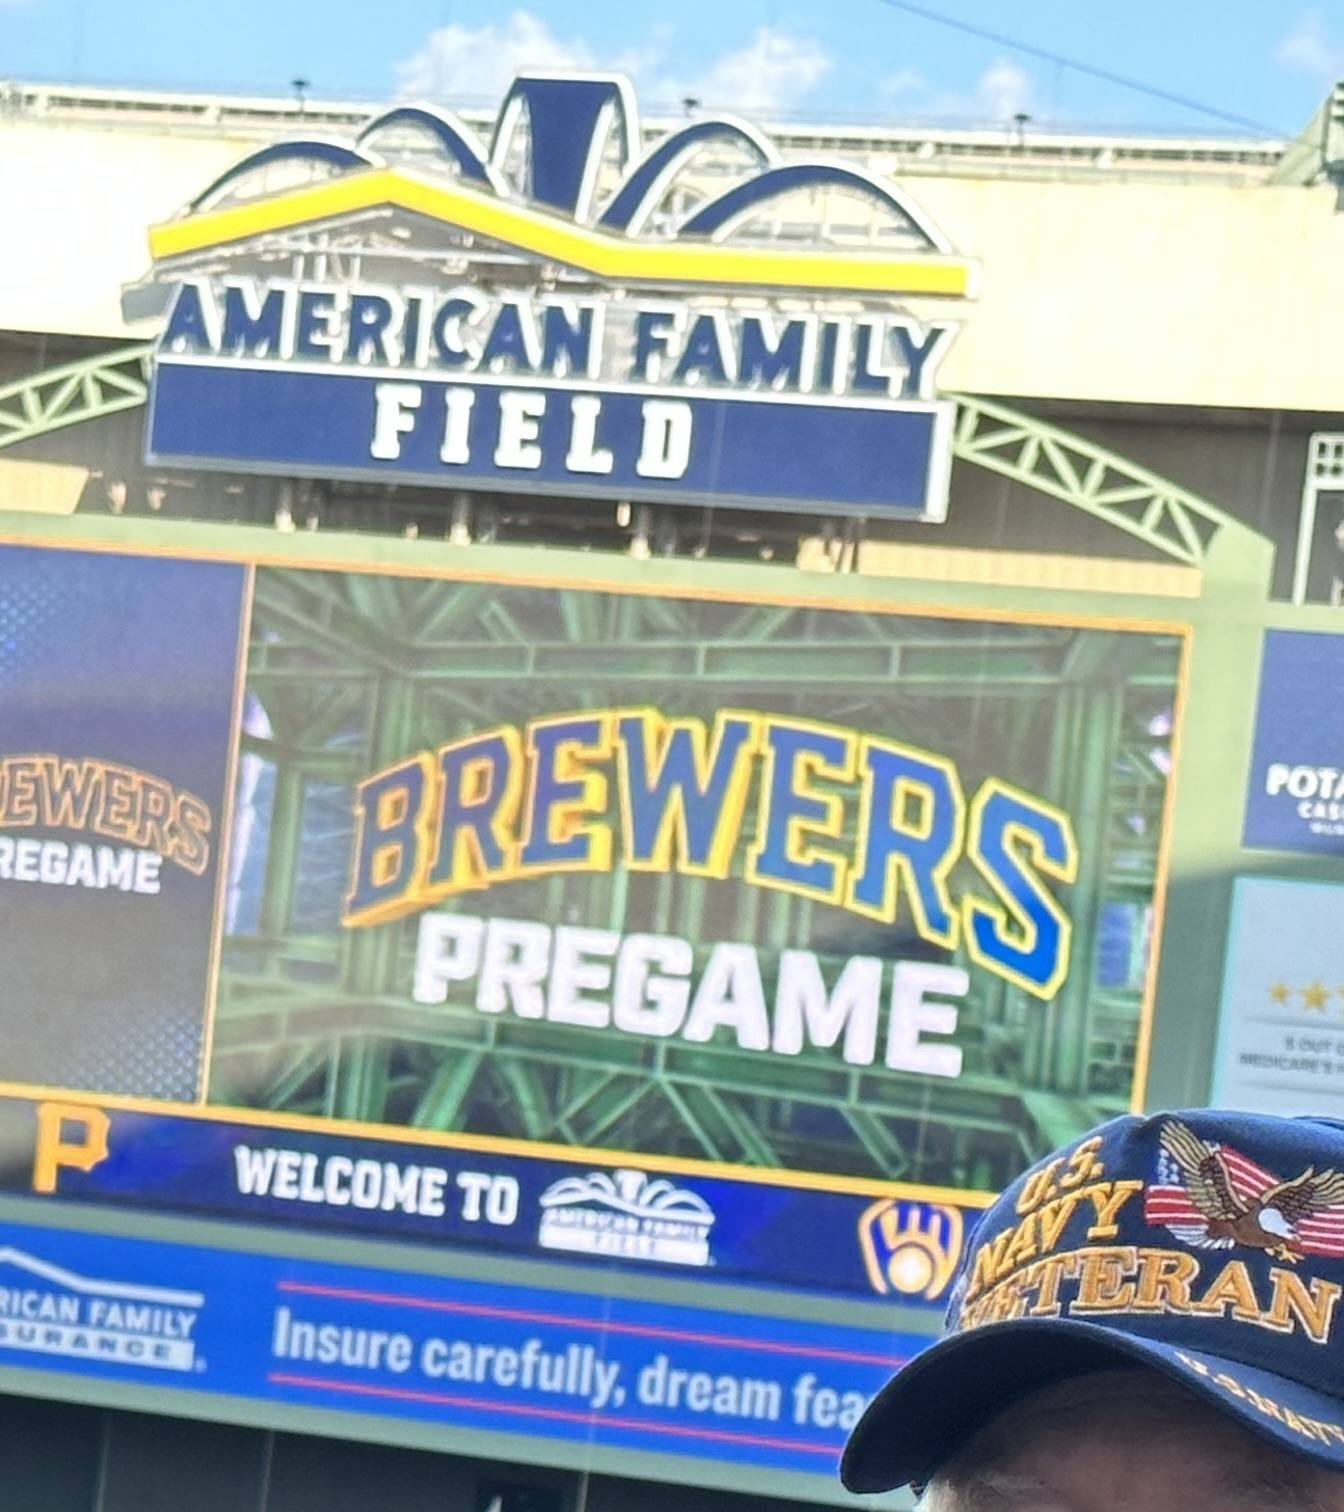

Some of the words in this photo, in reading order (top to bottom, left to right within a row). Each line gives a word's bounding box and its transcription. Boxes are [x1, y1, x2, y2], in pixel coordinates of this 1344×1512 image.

[161, 275, 606, 382] AMERICAN
[632, 307, 960, 400] FAMILY
[370, 381, 693, 480] FIELD
[343, 706, 1078, 1001] BREWERS
[413, 912, 969, 1078] PREGAME
[234, 1144, 448, 1218] WELCOME
[458, 1171, 520, 1226] TO
[1015, 1136, 1105, 1216] U.S.
[969, 1179, 1144, 1299] NAVY
[90, 1300, 197, 1337] FAMILY
[962, 1246, 1342, 1344] VETERAN
[273, 1306, 411, 1373] Insure
[421, 1339, 626, 1409] carefully,
[638, 1356, 779, 1420] dream
[793, 1372, 868, 1432] fea
